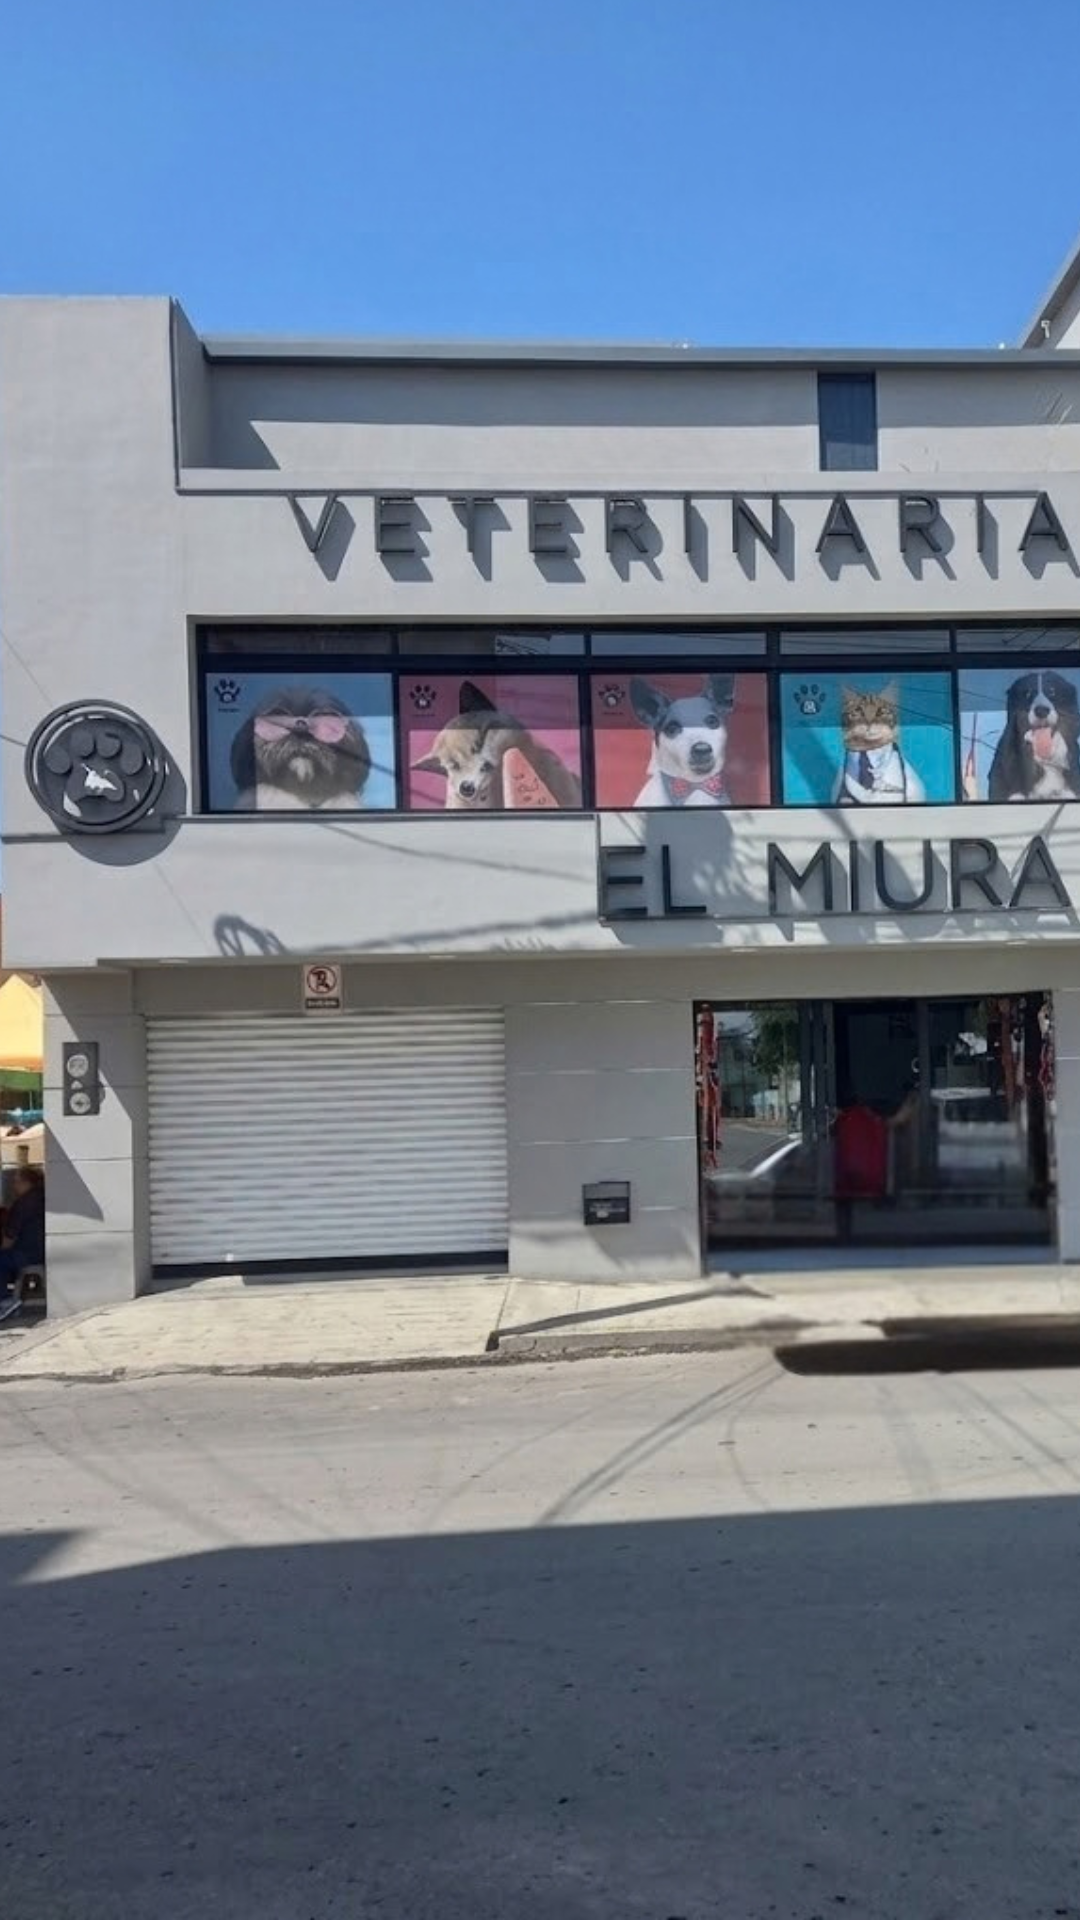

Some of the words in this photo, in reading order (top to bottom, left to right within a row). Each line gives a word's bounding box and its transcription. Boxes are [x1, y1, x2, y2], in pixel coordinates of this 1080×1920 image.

[288, 491, 1067, 553] VETERINARIA
[600, 844, 707, 915] EL
[767, 835, 1071, 912] MIURA
